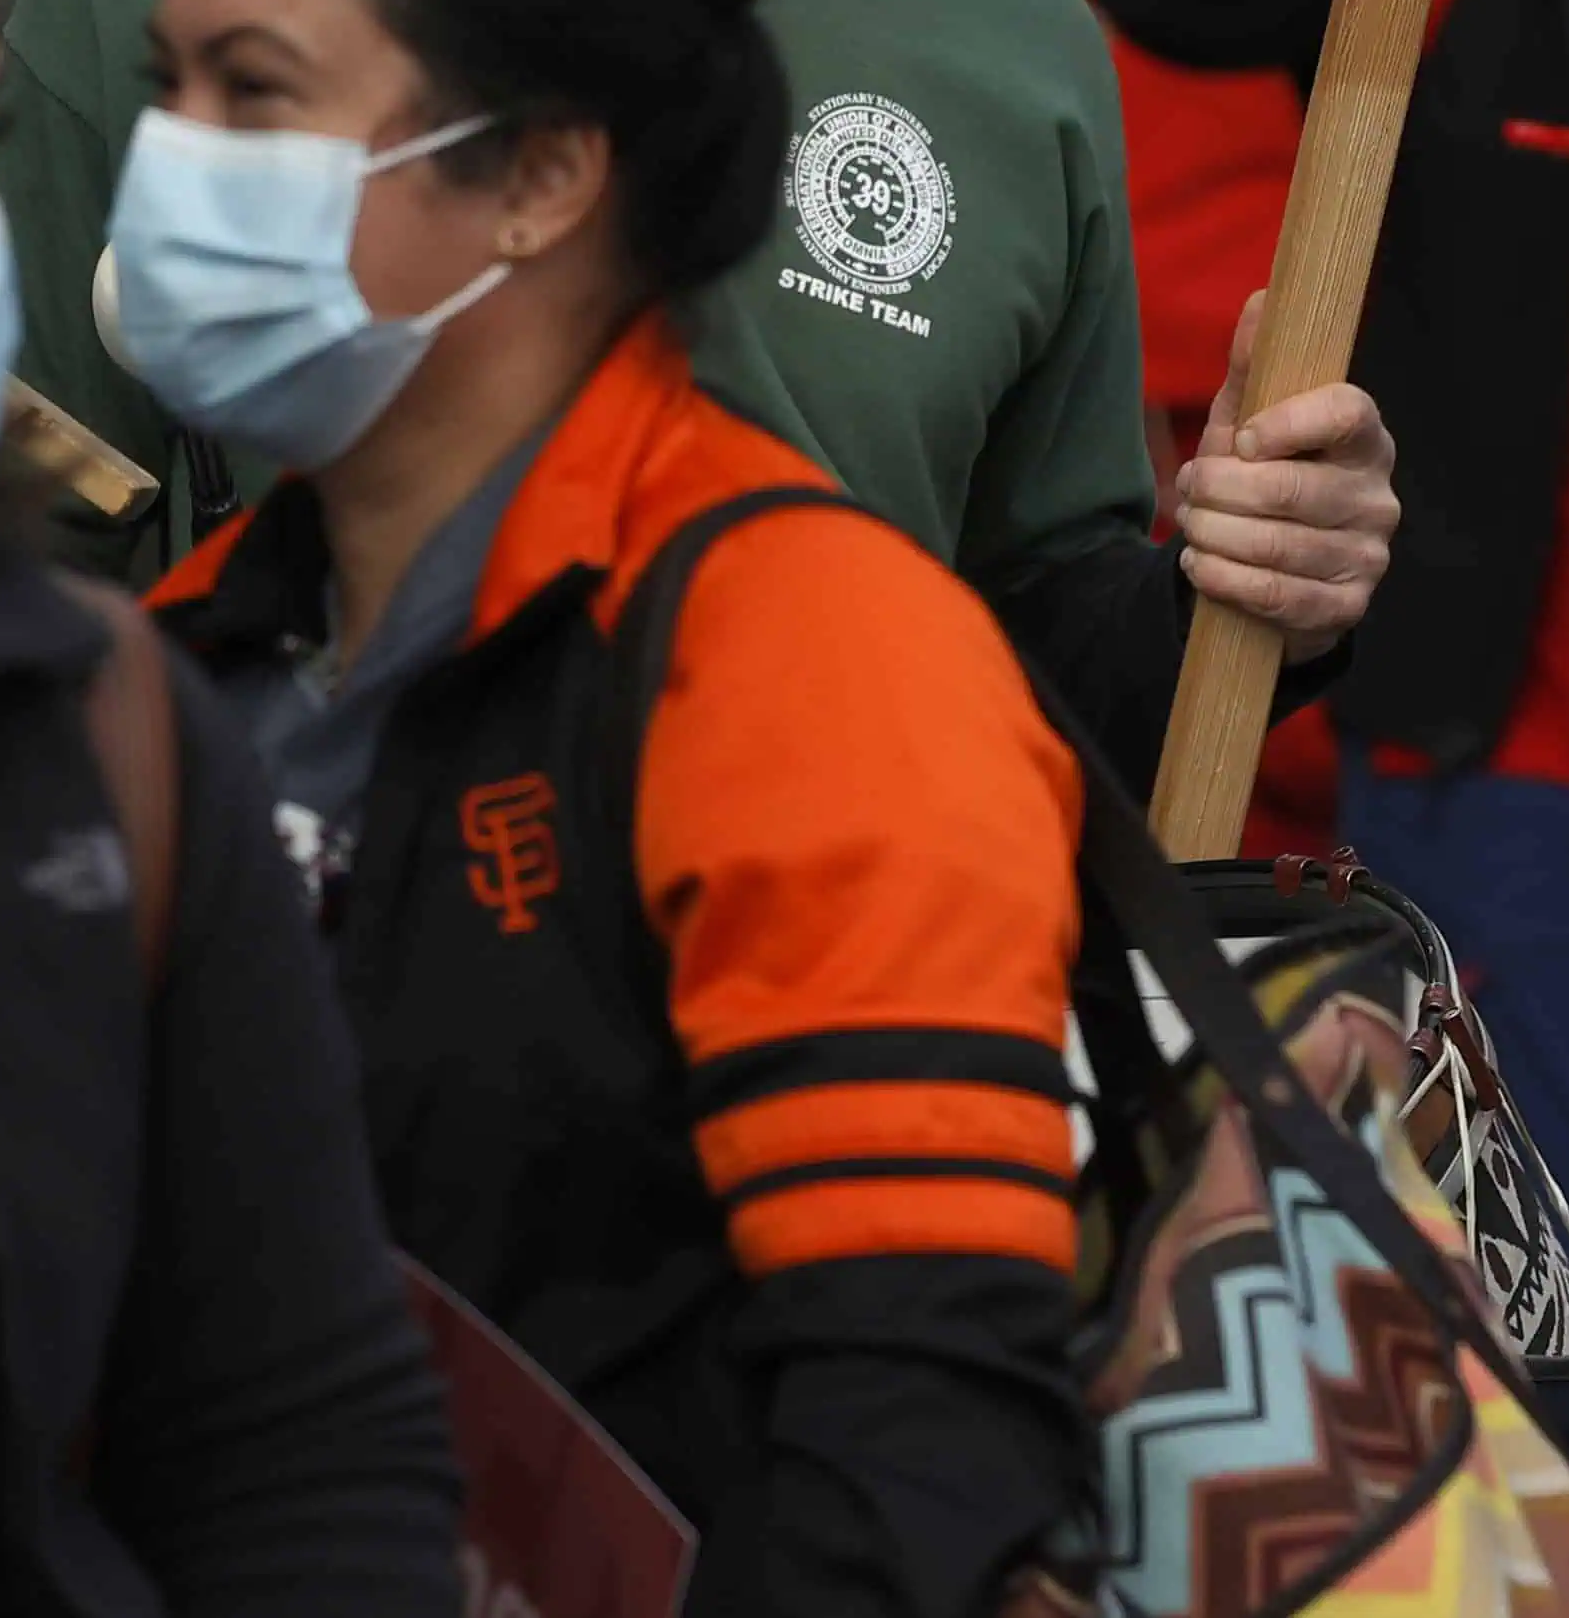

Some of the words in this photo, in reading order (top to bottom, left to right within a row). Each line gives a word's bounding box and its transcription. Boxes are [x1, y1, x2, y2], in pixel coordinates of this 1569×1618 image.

[808, 91, 875, 122] STATIONARY
[824, 111, 869, 134] UNION
[872, 113, 894, 130] OF
[815, 127, 876, 173] ORGANIZED
[850, 172, 891, 215] 39
[778, 268, 864, 313] STRIKE
[870, 299, 931, 338] TEAM
[460, 771, 561, 934] SF
